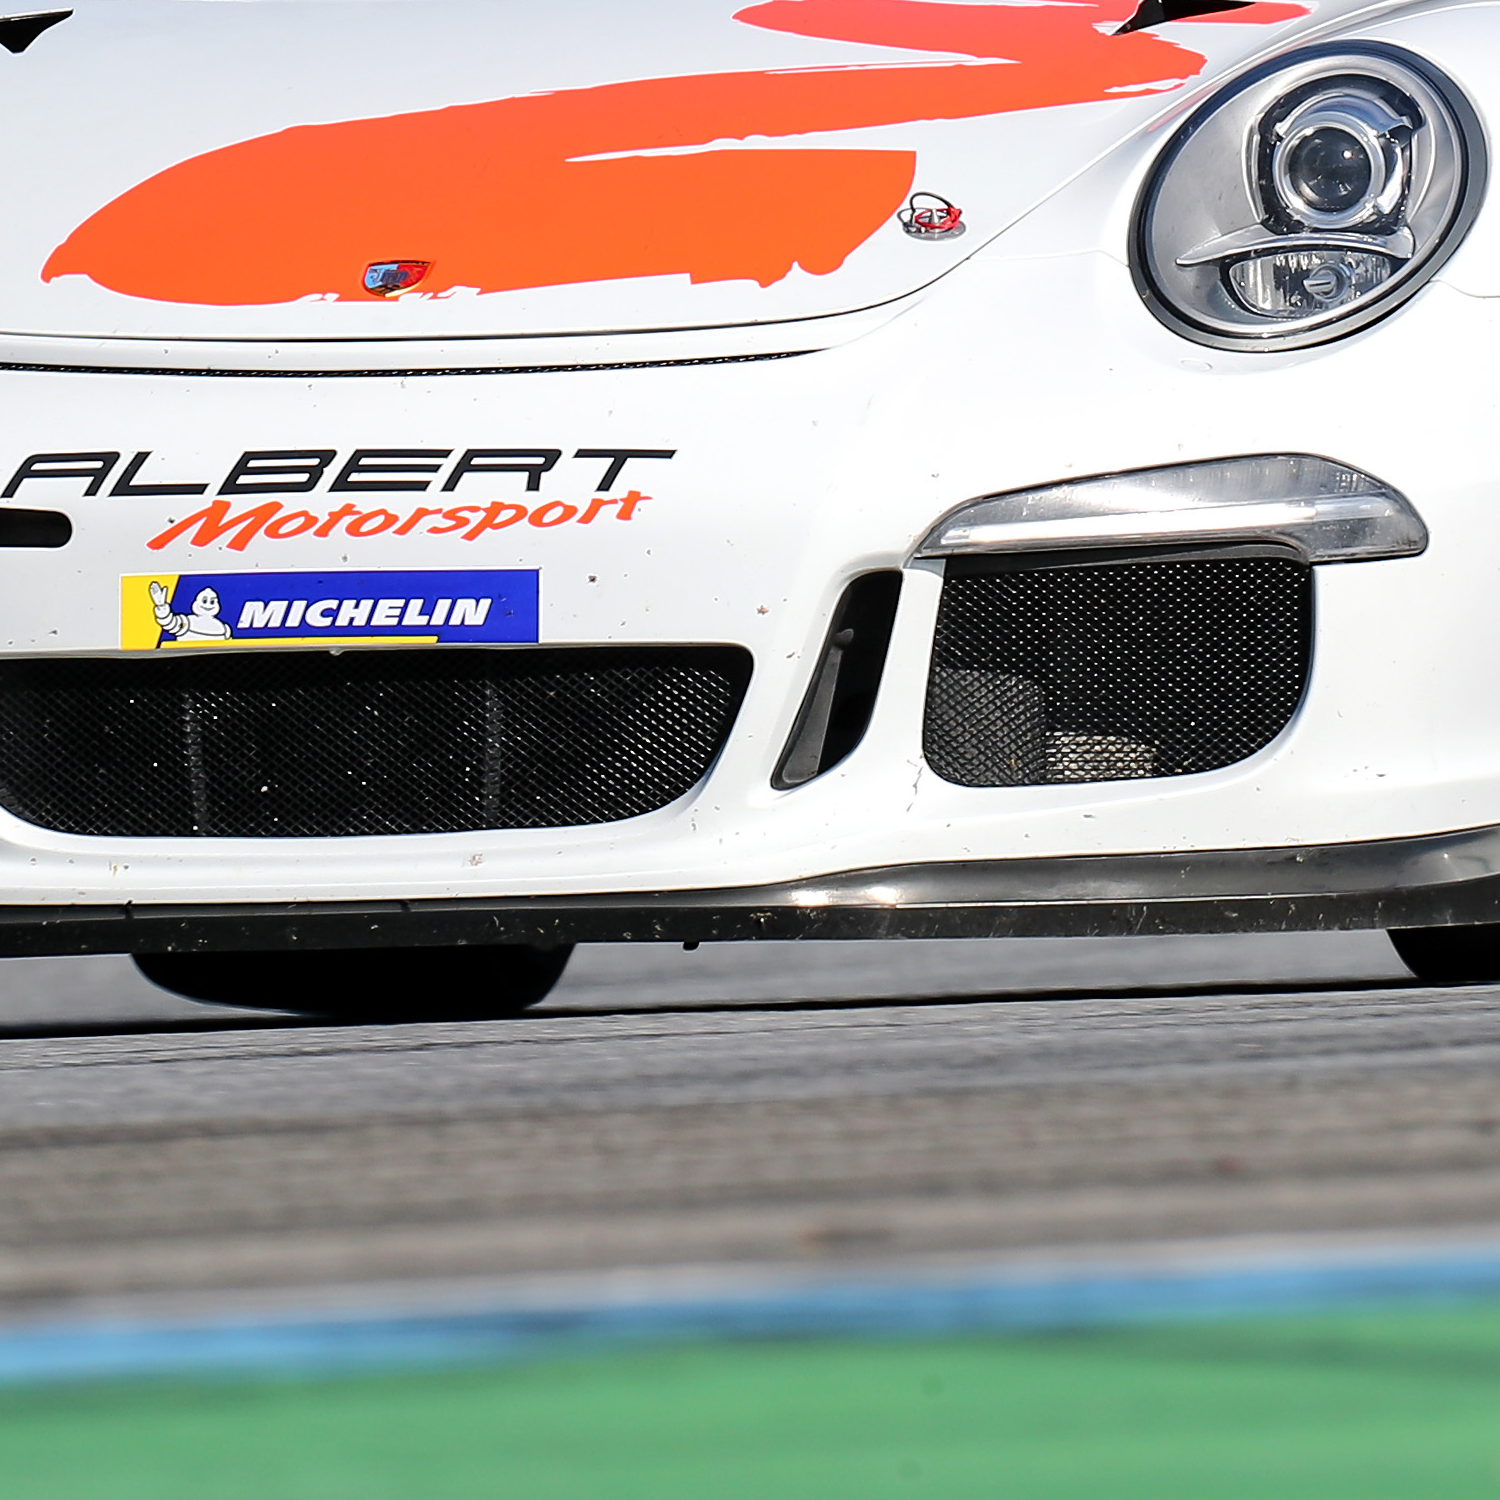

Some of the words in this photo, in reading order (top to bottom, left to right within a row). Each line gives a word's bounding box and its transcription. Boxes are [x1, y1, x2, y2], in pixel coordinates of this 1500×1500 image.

[0, 448, 678, 499] ALBERT
[145, 490, 653, 552] Motorsport
[236, 597, 493, 630] MICHELIN
